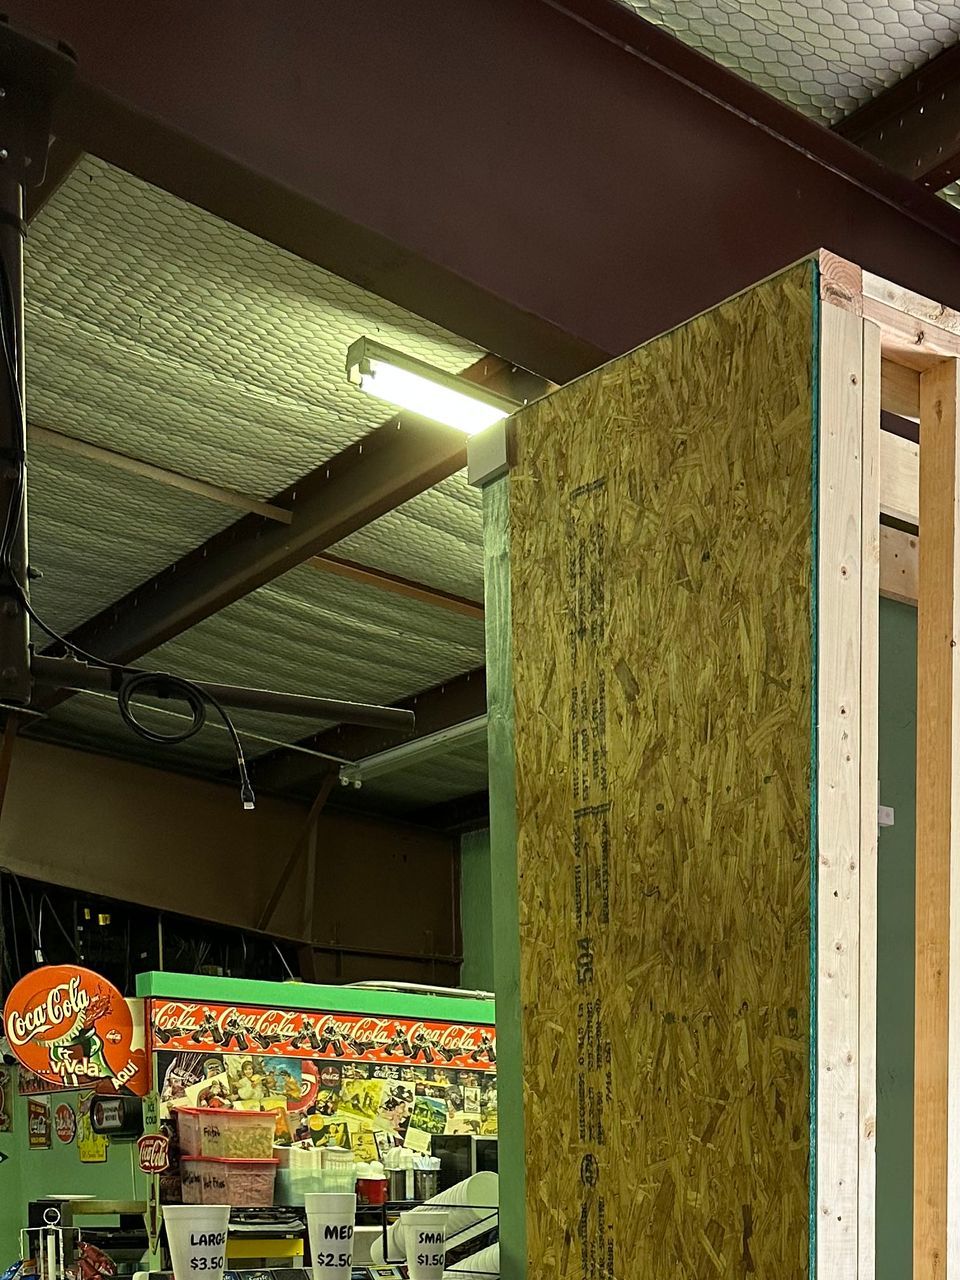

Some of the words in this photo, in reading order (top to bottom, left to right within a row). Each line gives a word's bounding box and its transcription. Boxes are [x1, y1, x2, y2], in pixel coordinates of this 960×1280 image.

[576, 937, 594, 986] 504
[7, 975, 90, 1046] Coca-Cola
[190, 1232, 226, 1246] LARGE
[190, 1256, 224, 1270] $3.50
[417, 1253, 444, 1266] $1.50
